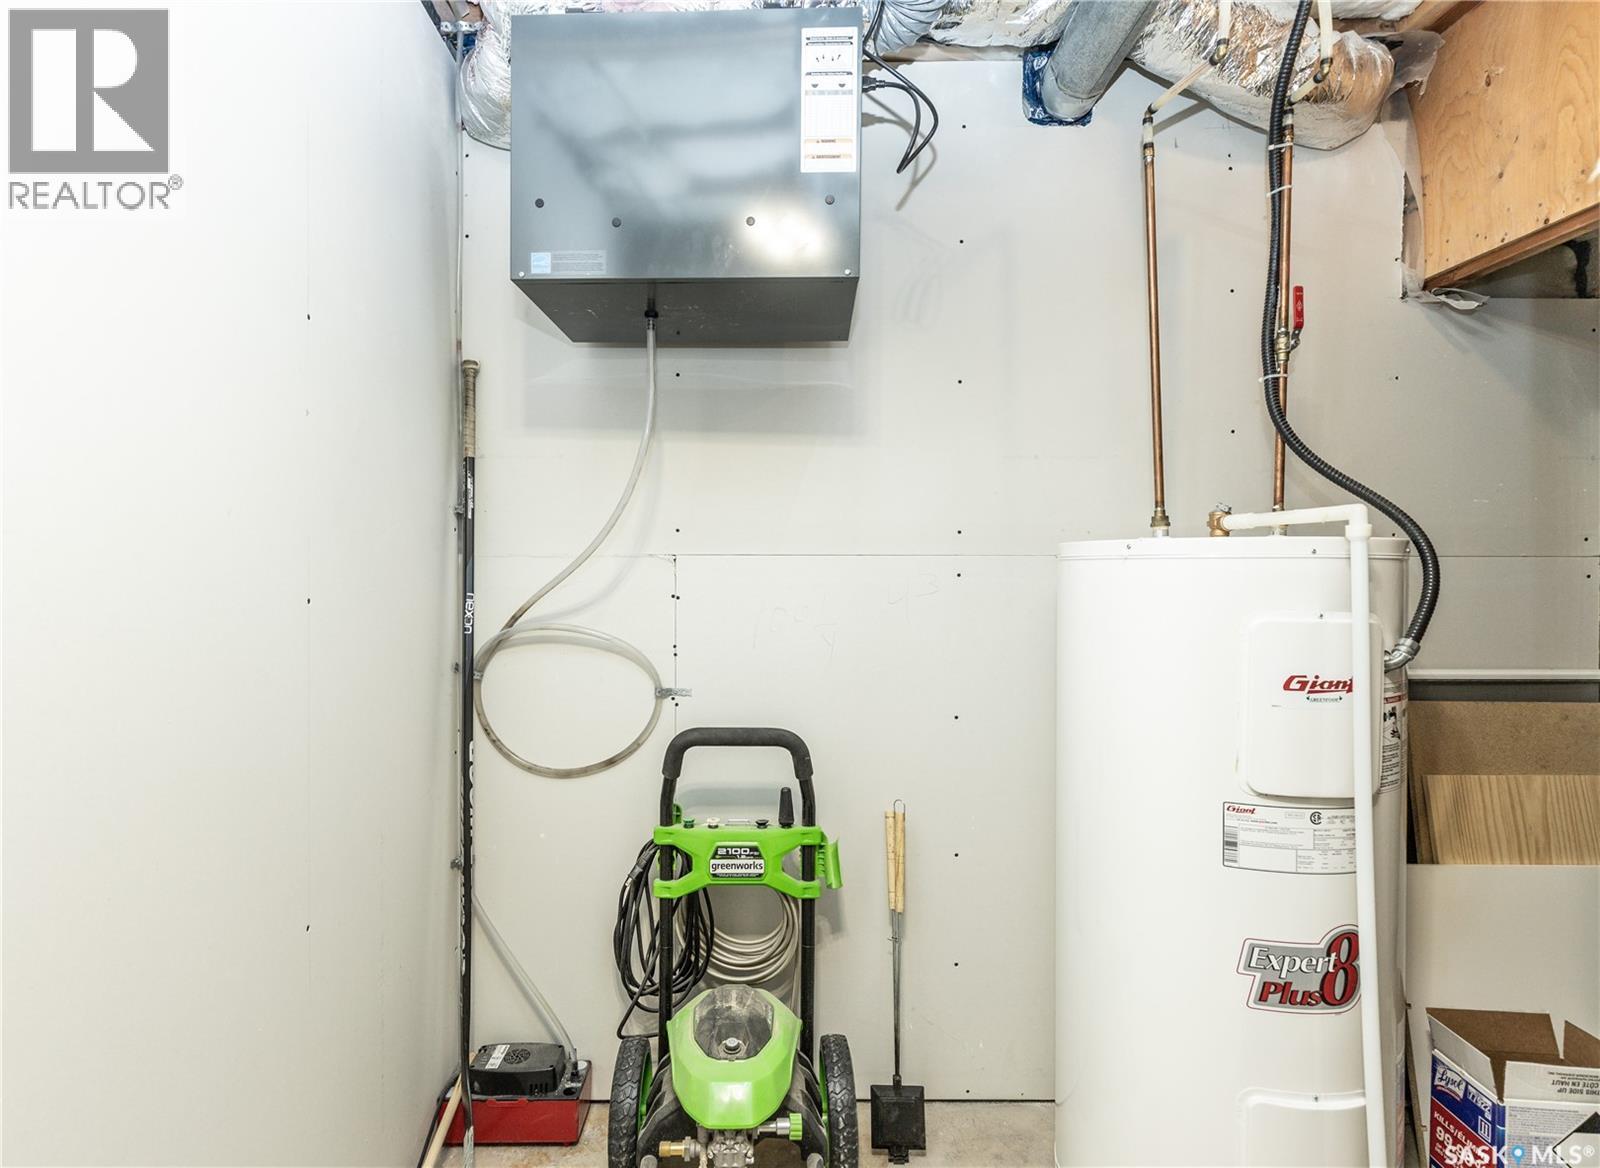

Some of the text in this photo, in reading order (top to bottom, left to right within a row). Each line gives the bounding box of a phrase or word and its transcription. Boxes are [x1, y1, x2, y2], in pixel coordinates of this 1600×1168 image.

[717, 847, 750, 855] 2100
[711, 861, 763, 872] greenworks
[1248, 946, 1338, 979] Expert
[1320, 932, 1360, 1006] 8
[1258, 981, 1323, 1007] Plus
